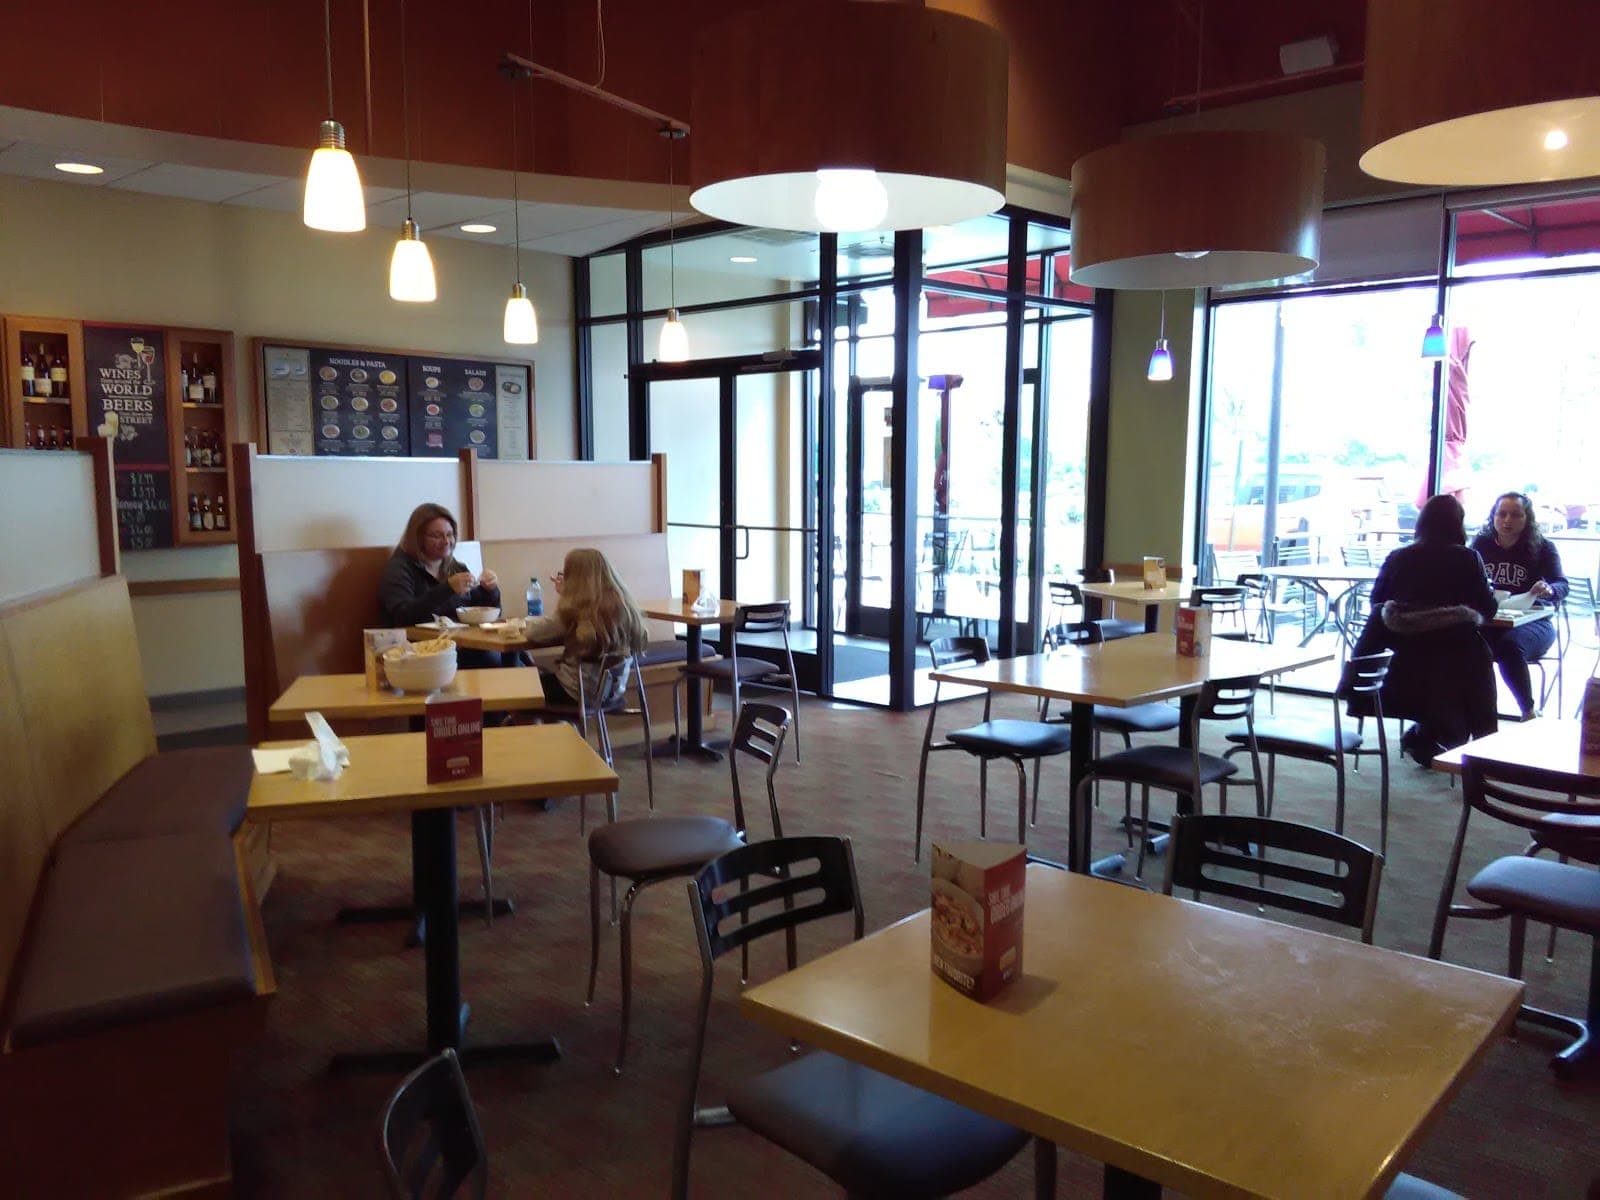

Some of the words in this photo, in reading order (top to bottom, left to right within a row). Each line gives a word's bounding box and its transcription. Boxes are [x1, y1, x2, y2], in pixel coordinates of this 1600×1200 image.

[329, 357, 360, 367] NOODLES
[366, 359, 386, 368] PASTA
[99, 367, 141, 380] WINES
[101, 383, 153, 396] WORLD
[101, 398, 153, 412] BEERS
[119, 416, 153, 425] STREET
[433, 725, 457, 738] ORDER
[457, 720, 481, 736] ONLINE
